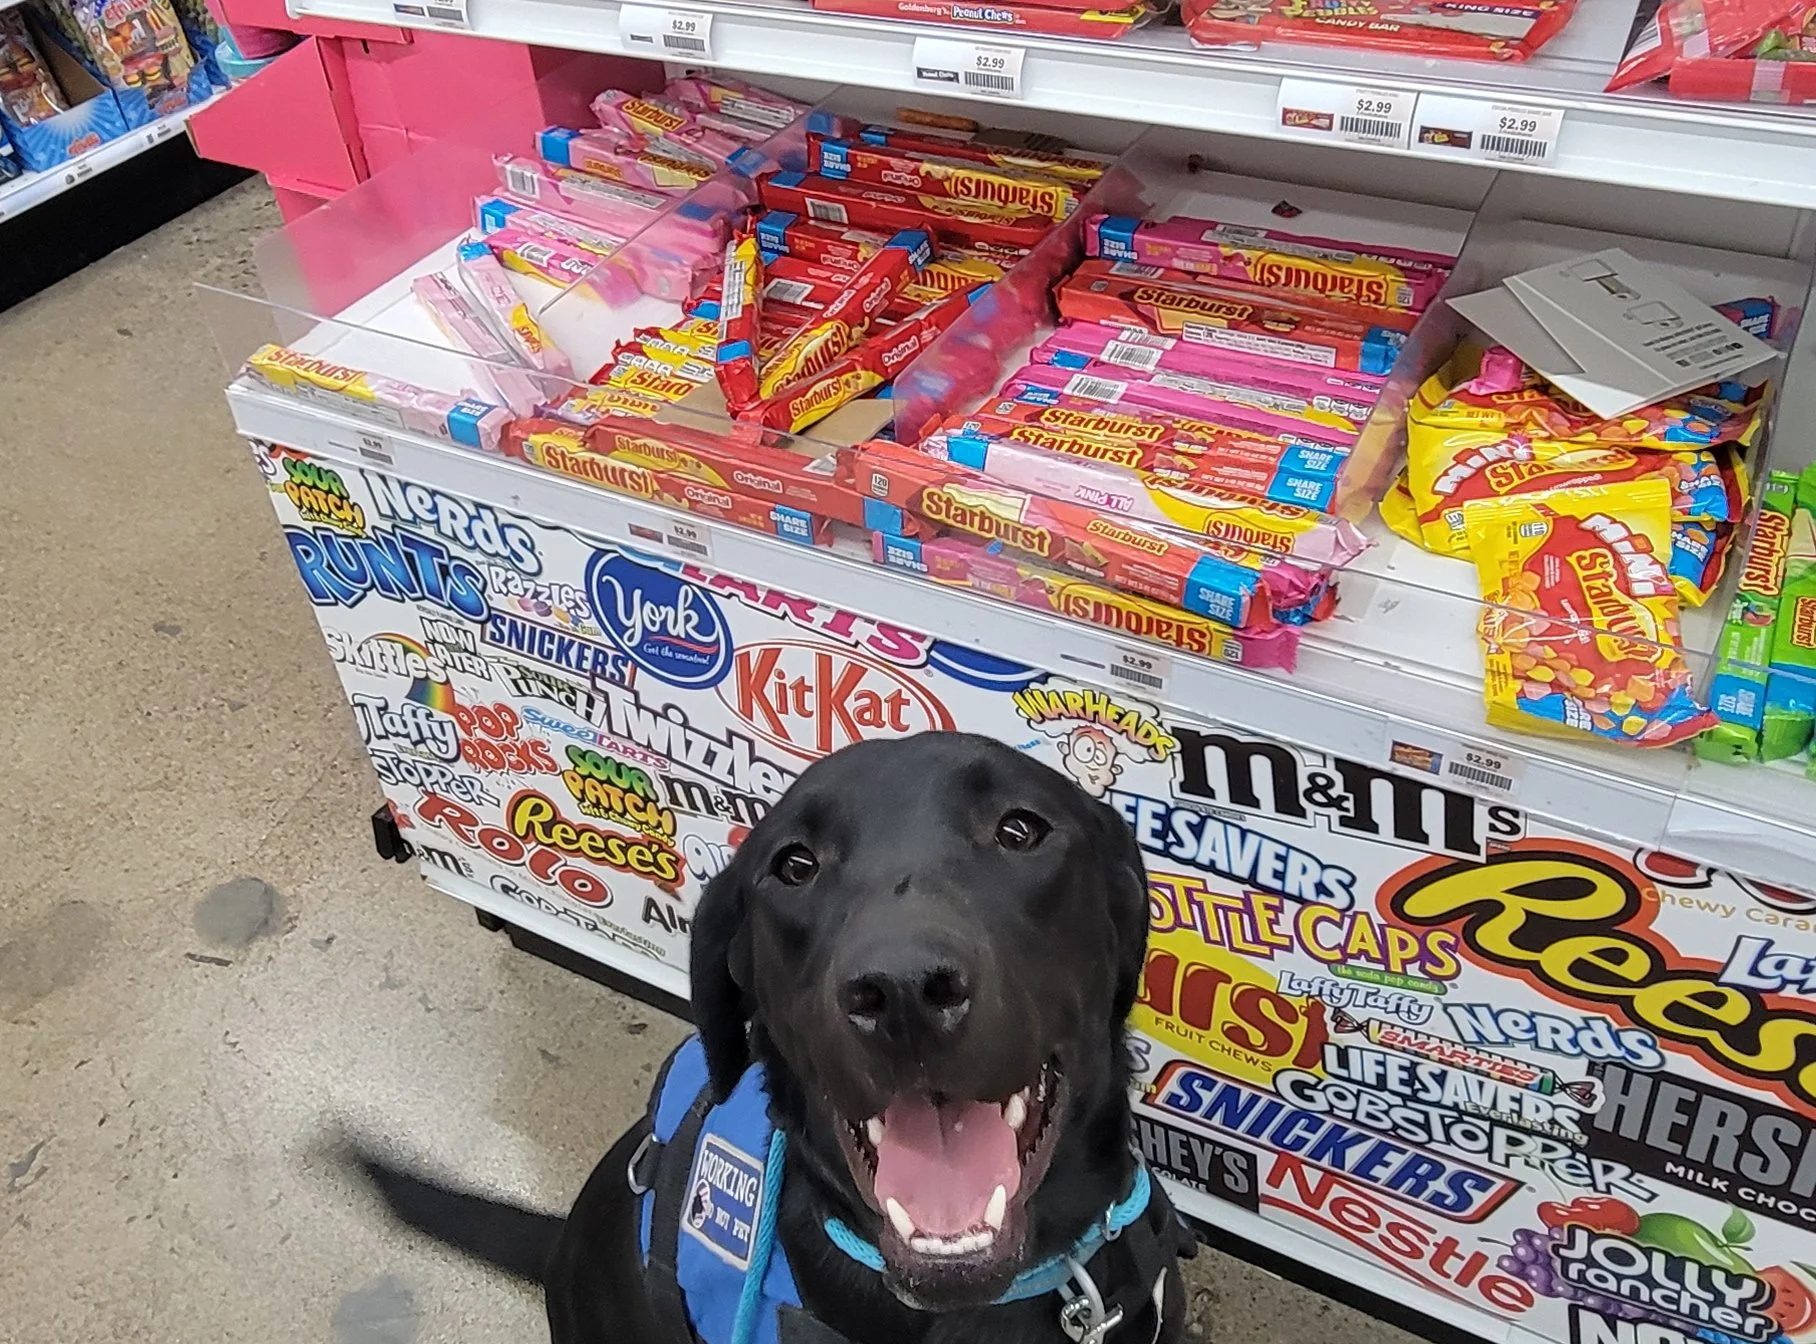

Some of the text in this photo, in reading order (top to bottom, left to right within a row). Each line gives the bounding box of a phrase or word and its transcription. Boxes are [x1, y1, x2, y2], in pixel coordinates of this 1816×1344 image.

[671, 19, 696, 33] $2.99
[952, 4, 1014, 23] Peanut Chews
[1315, 17, 1401, 32] CANDY BAR
[1444, 1, 1537, 17] KING SIZE
[975, 55, 1005, 71] $2.99
[622, 98, 687, 132] Starburst
[1356, 98, 1392, 116] $2.99
[1499, 116, 1537, 134] $2.99
[881, 169, 923, 188] Original
[949, 170, 1056, 216] Starburst
[1102, 239, 1126, 249] SIZE
[1102, 247, 1138, 260] SHARE
[862, 276, 892, 313] Original
[1255, 257, 1389, 307] Starburst
[1134, 286, 1254, 321] Starburst
[266, 348, 362, 383] Starburst
[881, 335, 920, 367] Original
[789, 375, 844, 420] Starburst
[1040, 407, 1165, 443] Starburst
[615, 434, 680, 469] Starburst
[1009, 426, 1144, 469] Starburst
[1297, 448, 1335, 463] SHARE
[1304, 458, 1329, 471] SIZE
[282, 456, 349, 499] SOUR
[541, 441, 653, 500] Starburst
[733, 470, 783, 494] Original
[873, 473, 888, 488] 120
[1286, 476, 1323, 492] SHARE
[283, 478, 366, 530] PATCH
[685, 486, 732, 508] Original
[1076, 485, 1135, 512] ALL PINK
[1294, 487, 1319, 501] SIZE
[769, 510, 809, 529] SHARE
[783, 523, 810, 537] SIZE
[922, 487, 1051, 557] Starburst
[1087, 518, 1169, 556] Starburst
[887, 545, 915, 561] SIZE
[887, 557, 929, 573] SHARE
[1679, 540, 1708, 563] SIZE
[1738, 508, 1791, 597] Starburst
[283, 524, 493, 624] RUNTS
[486, 562, 593, 621] Razzles
[601, 573, 721, 648] York
[1198, 587, 1235, 608] SHARE
[1207, 602, 1234, 621] SIZE
[1566, 547, 1664, 664] Starburst
[419, 613, 478, 654] NOW
[1059, 583, 1213, 656] Starburst
[324, 624, 452, 685] Skittles
[489, 611, 631, 687] SNICKERS
[642, 642, 660, 657] Get
[660, 645, 675, 659] the
[1122, 654, 1153, 670] $2.99
[452, 701, 524, 742] POP
[1011, 687, 1177, 763] WARHEADS
[1565, 699, 1579, 727] SIZE
[592, 671, 800, 798] Twizzle
[458, 735, 563, 777] ROCKS
[564, 744, 656, 802] SOUR
[1465, 752, 1502, 770] $2.99
[561, 767, 678, 835] PATCH
[511, 795, 679, 878] Reese's
[608, 810, 676, 846] Chewy Candy
[413, 790, 615, 909] ROLO
[1167, 805, 1357, 913] SAVERS
[1744, 905, 1816, 934] Cara
[1293, 901, 1463, 982] CAPS
[1336, 964, 1439, 993] the soda pop candy
[1402, 856, 1816, 1104] Rees
[1154, 1016, 1273, 1073] FRUIT CHEWS
[1379, 1029, 1539, 1084] SMARTIES
[1163, 1069, 1496, 1214] SNICKERS
[1464, 1101, 1589, 1147] Everlasting
[1593, 1060, 1816, 1201] HERS
[700, 1149, 758, 1208] WORKING
[1664, 1159, 1731, 1195] MILK
[1558, 1226, 1774, 1312] JOLLY
[1566, 1260, 1770, 1338] rancher
